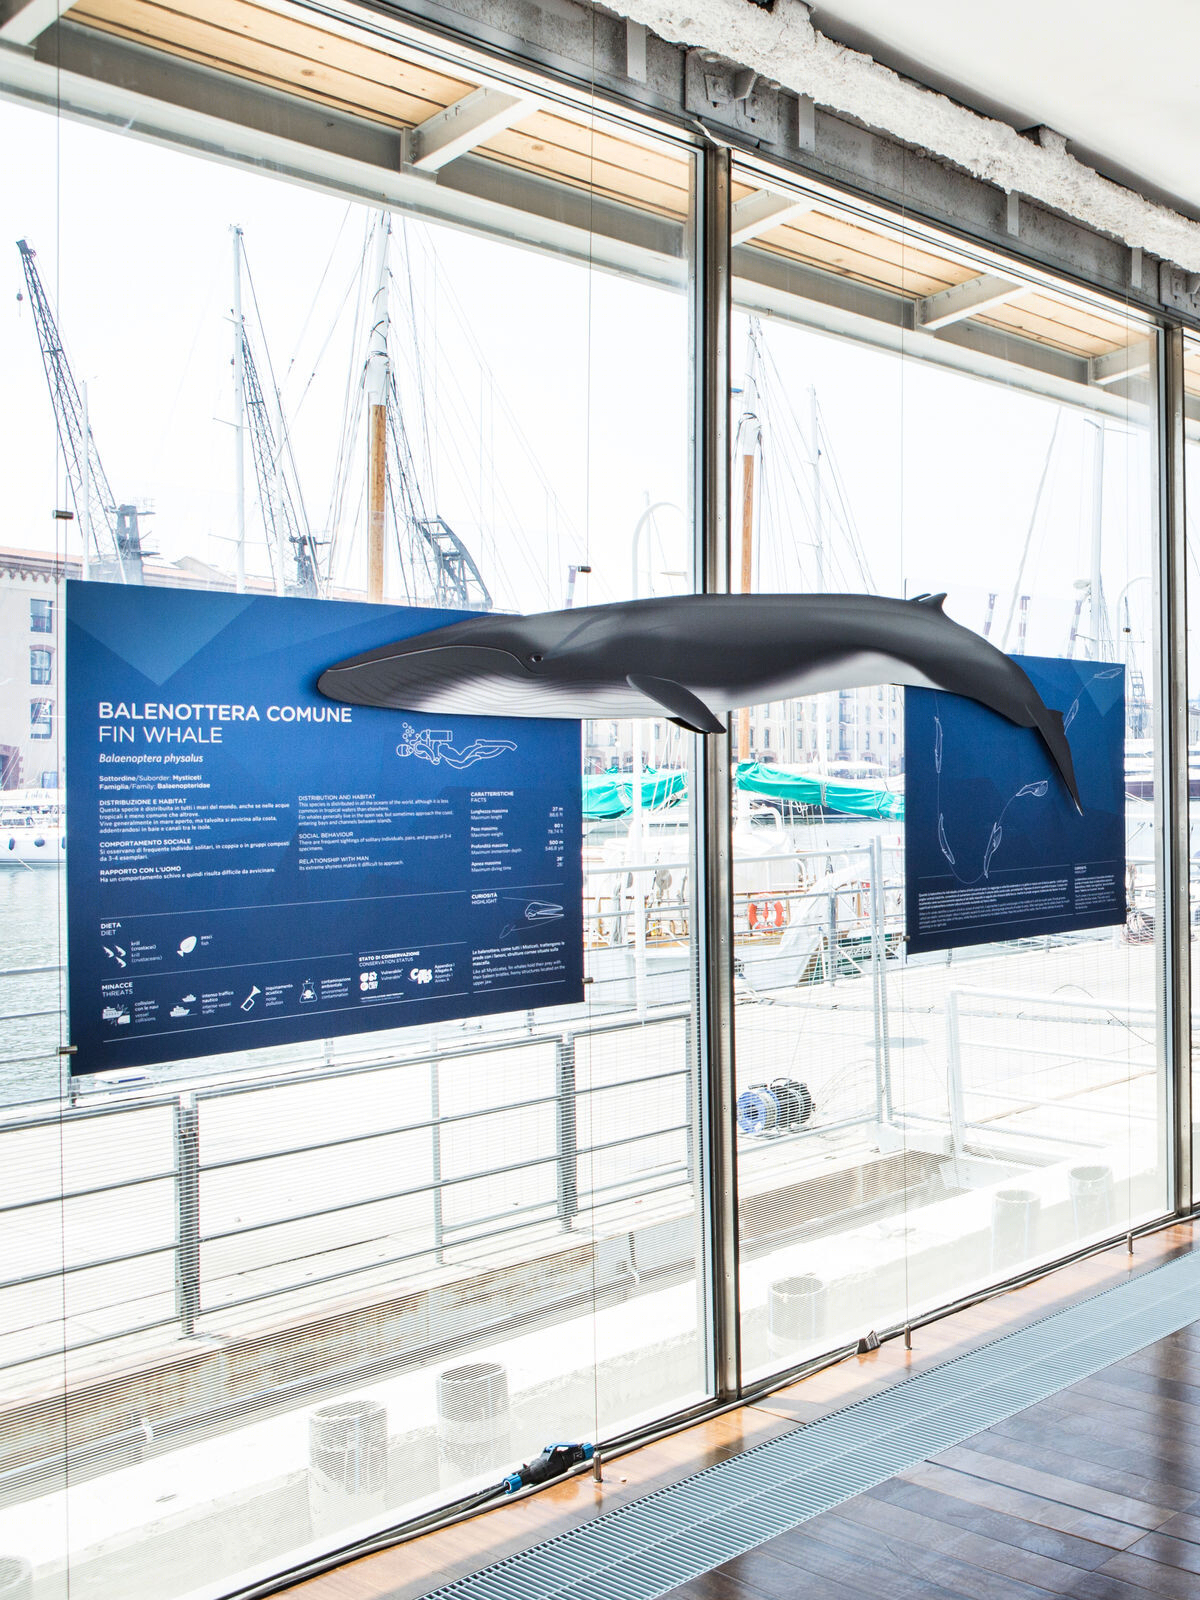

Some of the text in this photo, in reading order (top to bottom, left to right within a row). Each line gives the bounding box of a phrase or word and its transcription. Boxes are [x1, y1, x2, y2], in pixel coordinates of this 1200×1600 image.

[98, 702, 353, 723] BALENOTTERA COMUNE
[98, 726, 223, 743] FIN WHALE
[99, 753, 204, 764] Balaenoptera physalus
[172, 774, 202, 782] Mysticeti
[99, 782, 211, 791] Famiglia/Family: Balaenopteridae
[100, 839, 162, 847] COMPORTAMENTO
[471, 891, 497, 900] CURIOSITÀ
[381, 950, 420, 959] CONSERVAZIONE
[359, 959, 395, 967] CONSERVATION
[101, 982, 133, 990] MINACCE
[102, 989, 134, 997] THREATS
